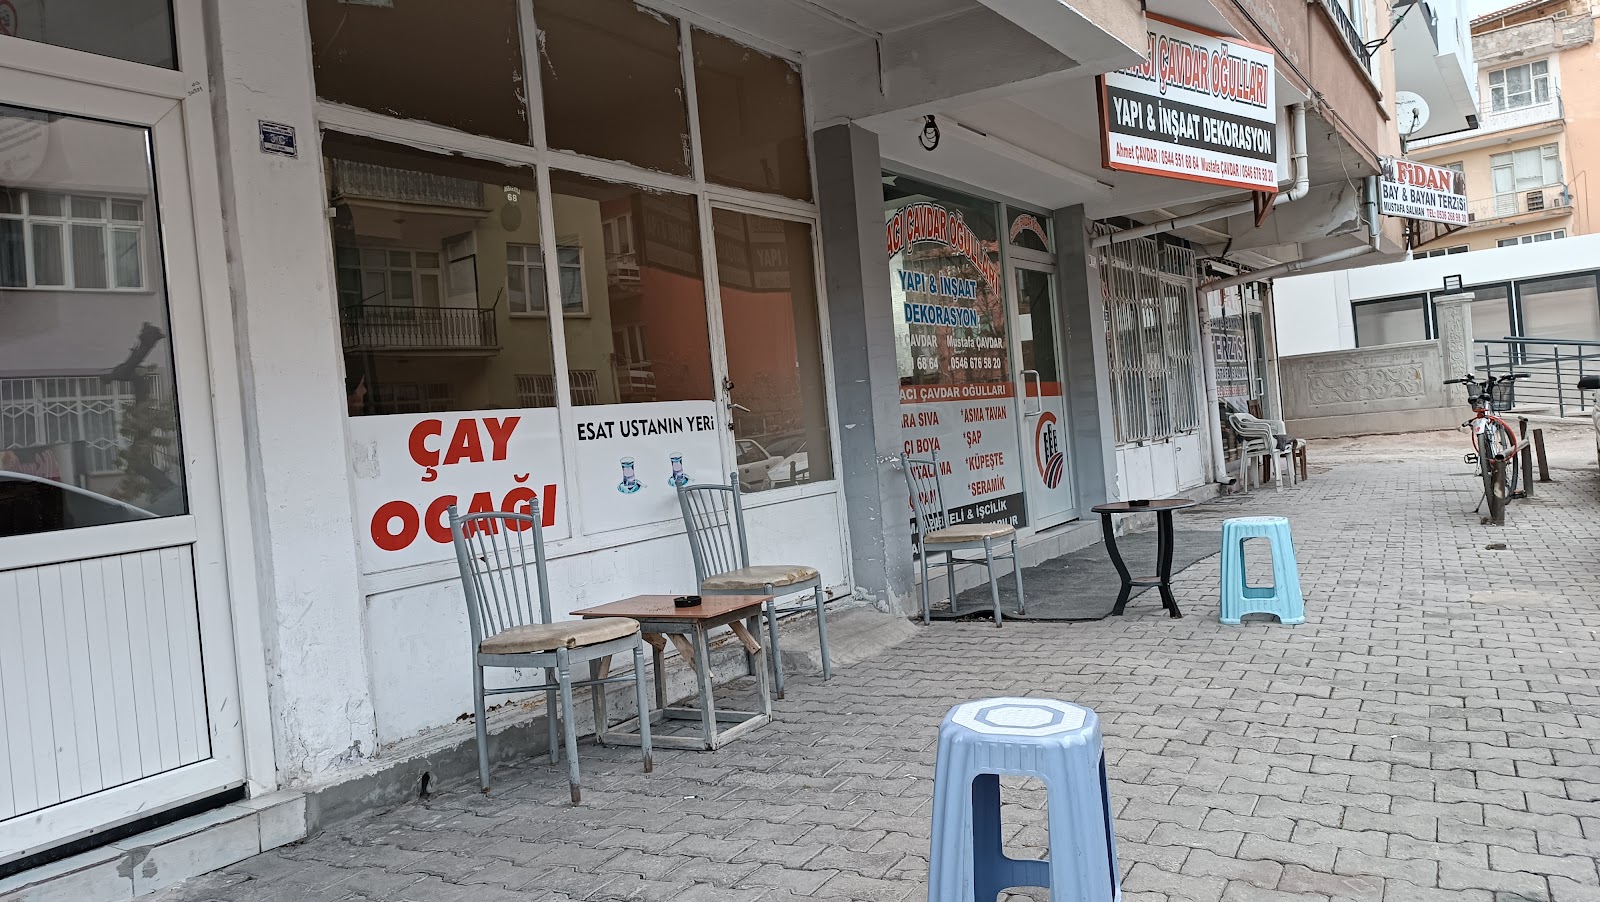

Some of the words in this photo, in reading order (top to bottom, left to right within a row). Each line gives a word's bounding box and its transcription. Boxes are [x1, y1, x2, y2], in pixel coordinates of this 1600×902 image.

[1159, 35, 1210, 95] ÇAVDAR
[1211, 43, 1268, 109] OĞULLARI
[1112, 96, 1143, 130] YAPI
[1146, 104, 1156, 132] &
[1158, 100, 1200, 143] İNŞAAT
[1203, 117, 1271, 154] DEKORASYON
[1116, 142, 1134, 160] Ahmet
[1135, 147, 1157, 167] ÇAVDAR
[1161, 150, 1174, 166] 0544
[1175, 153, 1185, 167] 551
[1192, 156, 1199, 170] 64
[1201, 157, 1220, 173] Mustafa
[1220, 161, 1239, 177] ÇAVDAR
[1242, 165, 1253, 179] 0546
[1253, 166, 1261, 180] 676
[507, 193, 517, 202] 68
[1382, 184, 1399, 200] BAY
[1402, 187, 1408, 202] &
[1410, 189, 1436, 206] BAYAN
[1383, 201, 1405, 214] MUSTAFA
[1406, 205, 1425, 217] SALMAN
[906, 202, 949, 255] ÇAVDAR
[949, 208, 1000, 299] OĞULLARI
[897, 268, 926, 293] YAPI
[929, 276, 938, 295] &
[940, 271, 977, 302] İNŞAAT
[904, 302, 979, 328] DEKORASYON
[947, 335, 975, 348] Mustafa
[975, 336, 1003, 351] ÇAVDAR
[917, 357, 928, 370] 68
[928, 357, 939, 370] 64
[950, 356, 968, 369] 0546
[969, 357, 982, 369] 676
[983, 357, 992, 369] 58
[992, 357, 1001, 369] 20
[920, 387, 960, 402] ÇAVDAR
[962, 384, 1006, 397] OĞULLARI
[901, 413, 916, 429] RA
[918, 411, 939, 427] SIVA
[986, 406, 1007, 421] TAVAN
[577, 421, 615, 441] ESAT
[620, 417, 683, 439] USTANIN
[408, 416, 521, 482] ÇAY
[916, 437, 941, 454] BOYA
[370, 473, 557, 551] OCAĞI
[967, 508, 975, 521] &
